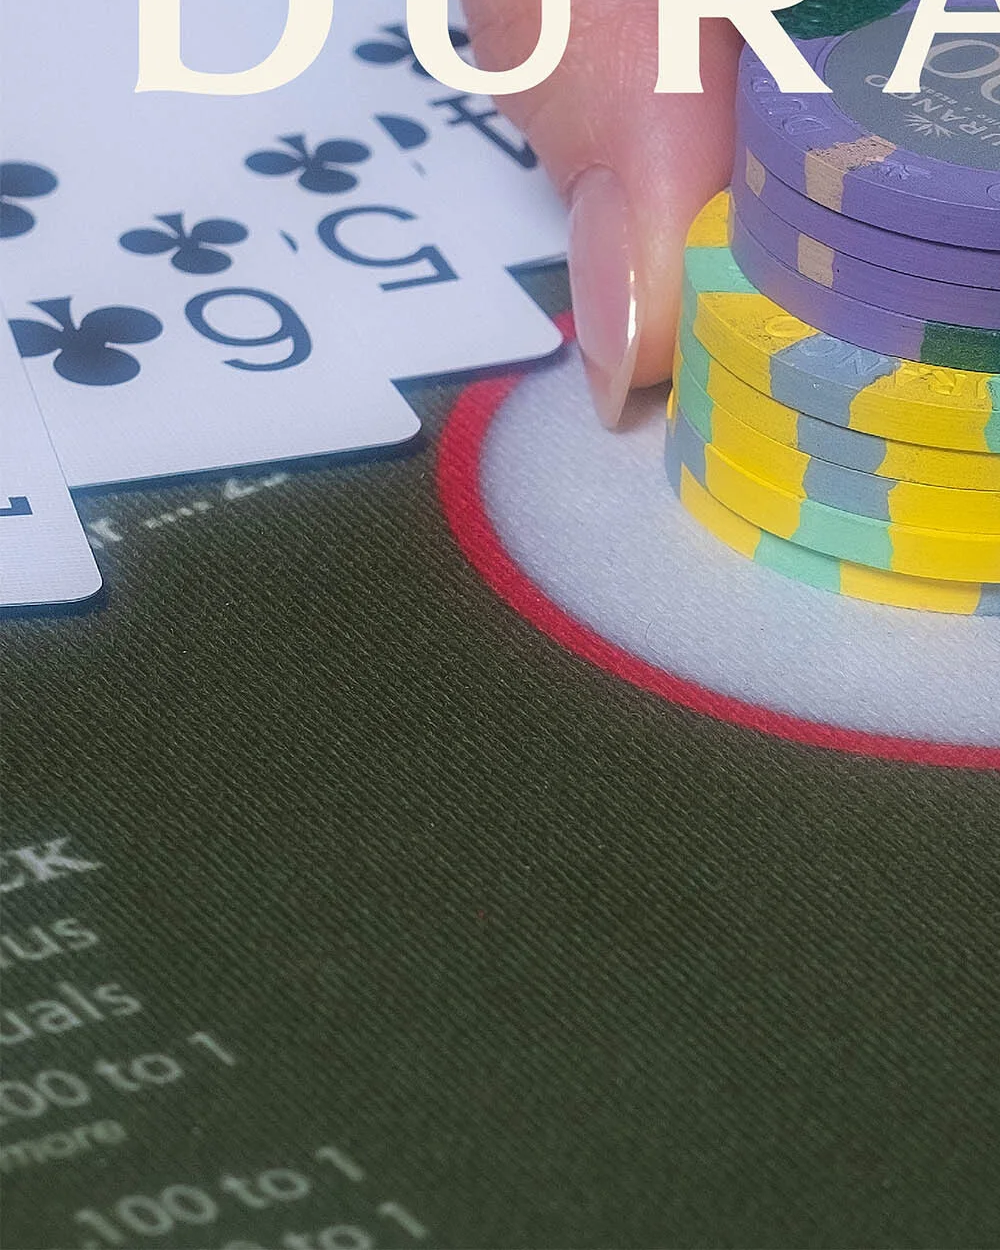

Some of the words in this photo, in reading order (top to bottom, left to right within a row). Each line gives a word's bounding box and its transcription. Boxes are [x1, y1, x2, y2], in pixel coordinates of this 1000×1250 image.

[316, 204, 460, 292] 5
[184, 286, 313, 372] 6
[95, 1053, 184, 1092] to
[188, 1031, 236, 1067] 1
[219, 1171, 311, 1210] to
[315, 1145, 365, 1182] 1
